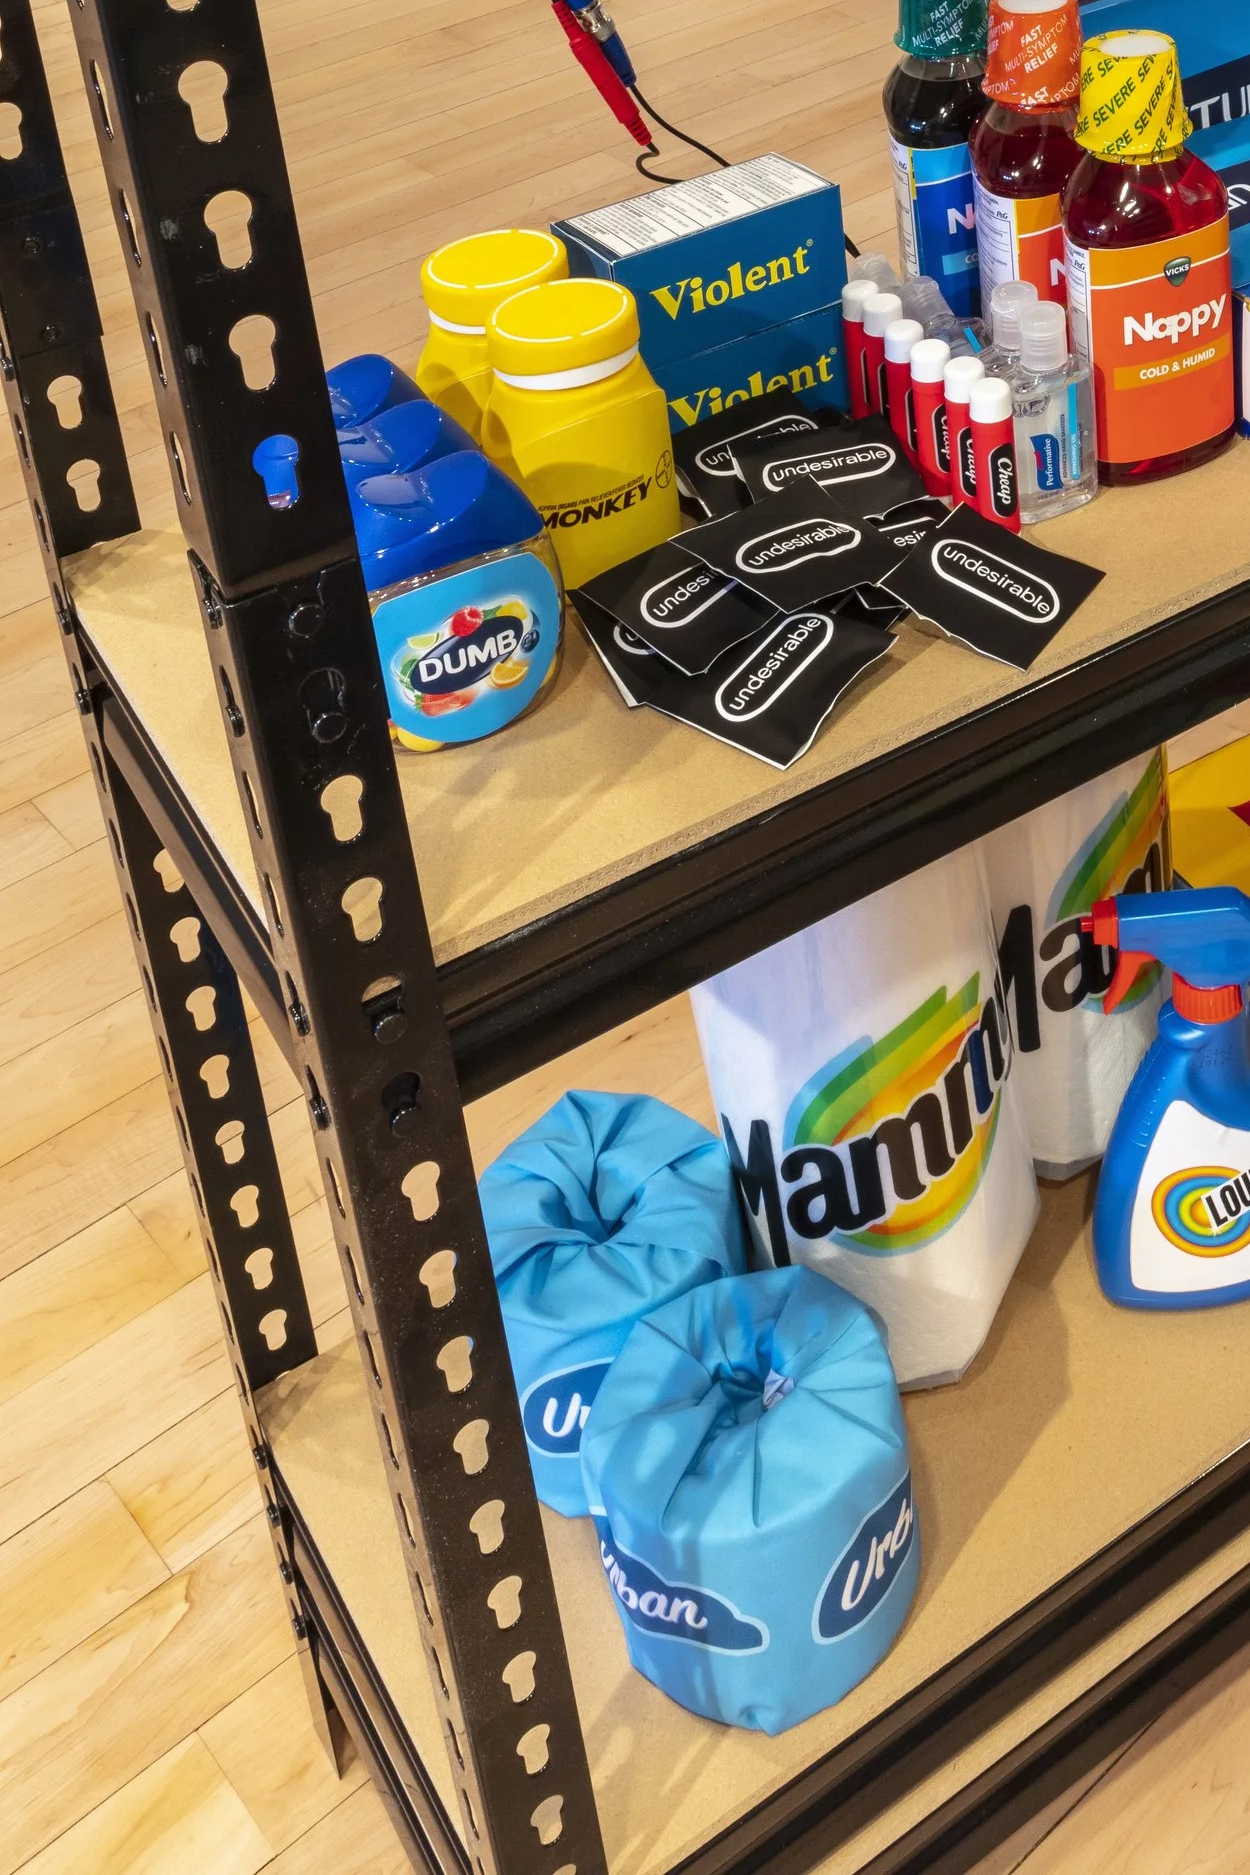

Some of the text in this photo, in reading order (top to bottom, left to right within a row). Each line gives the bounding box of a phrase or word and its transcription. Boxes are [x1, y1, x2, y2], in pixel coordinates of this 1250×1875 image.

[929, 1, 949, 23] FAST
[933, 18, 964, 47] RELIEF
[1020, 24, 1043, 47] FAST
[1004, 13, 1069, 73] MULTI-SYMPTOM
[1024, 42, 1059, 74] RELIEF
[1092, 76, 1136, 128] SEVERE
[1134, 75, 1166, 136] SEVERE
[649, 245, 810, 321] Violent
[1165, 263, 1190, 277] VICKS
[1123, 293, 1227, 346] Nappy
[1139, 347, 1216, 380] COLD & HUMID
[772, 448, 889, 482] undesirable
[997, 457, 1013, 505] Cheap
[1044, 438, 1054, 487] Performative
[539, 476, 653, 530] MONKEY
[943, 546, 1050, 615] undesirable
[418, 628, 518, 685] DUMB
[729, 617, 822, 712] undesirable
